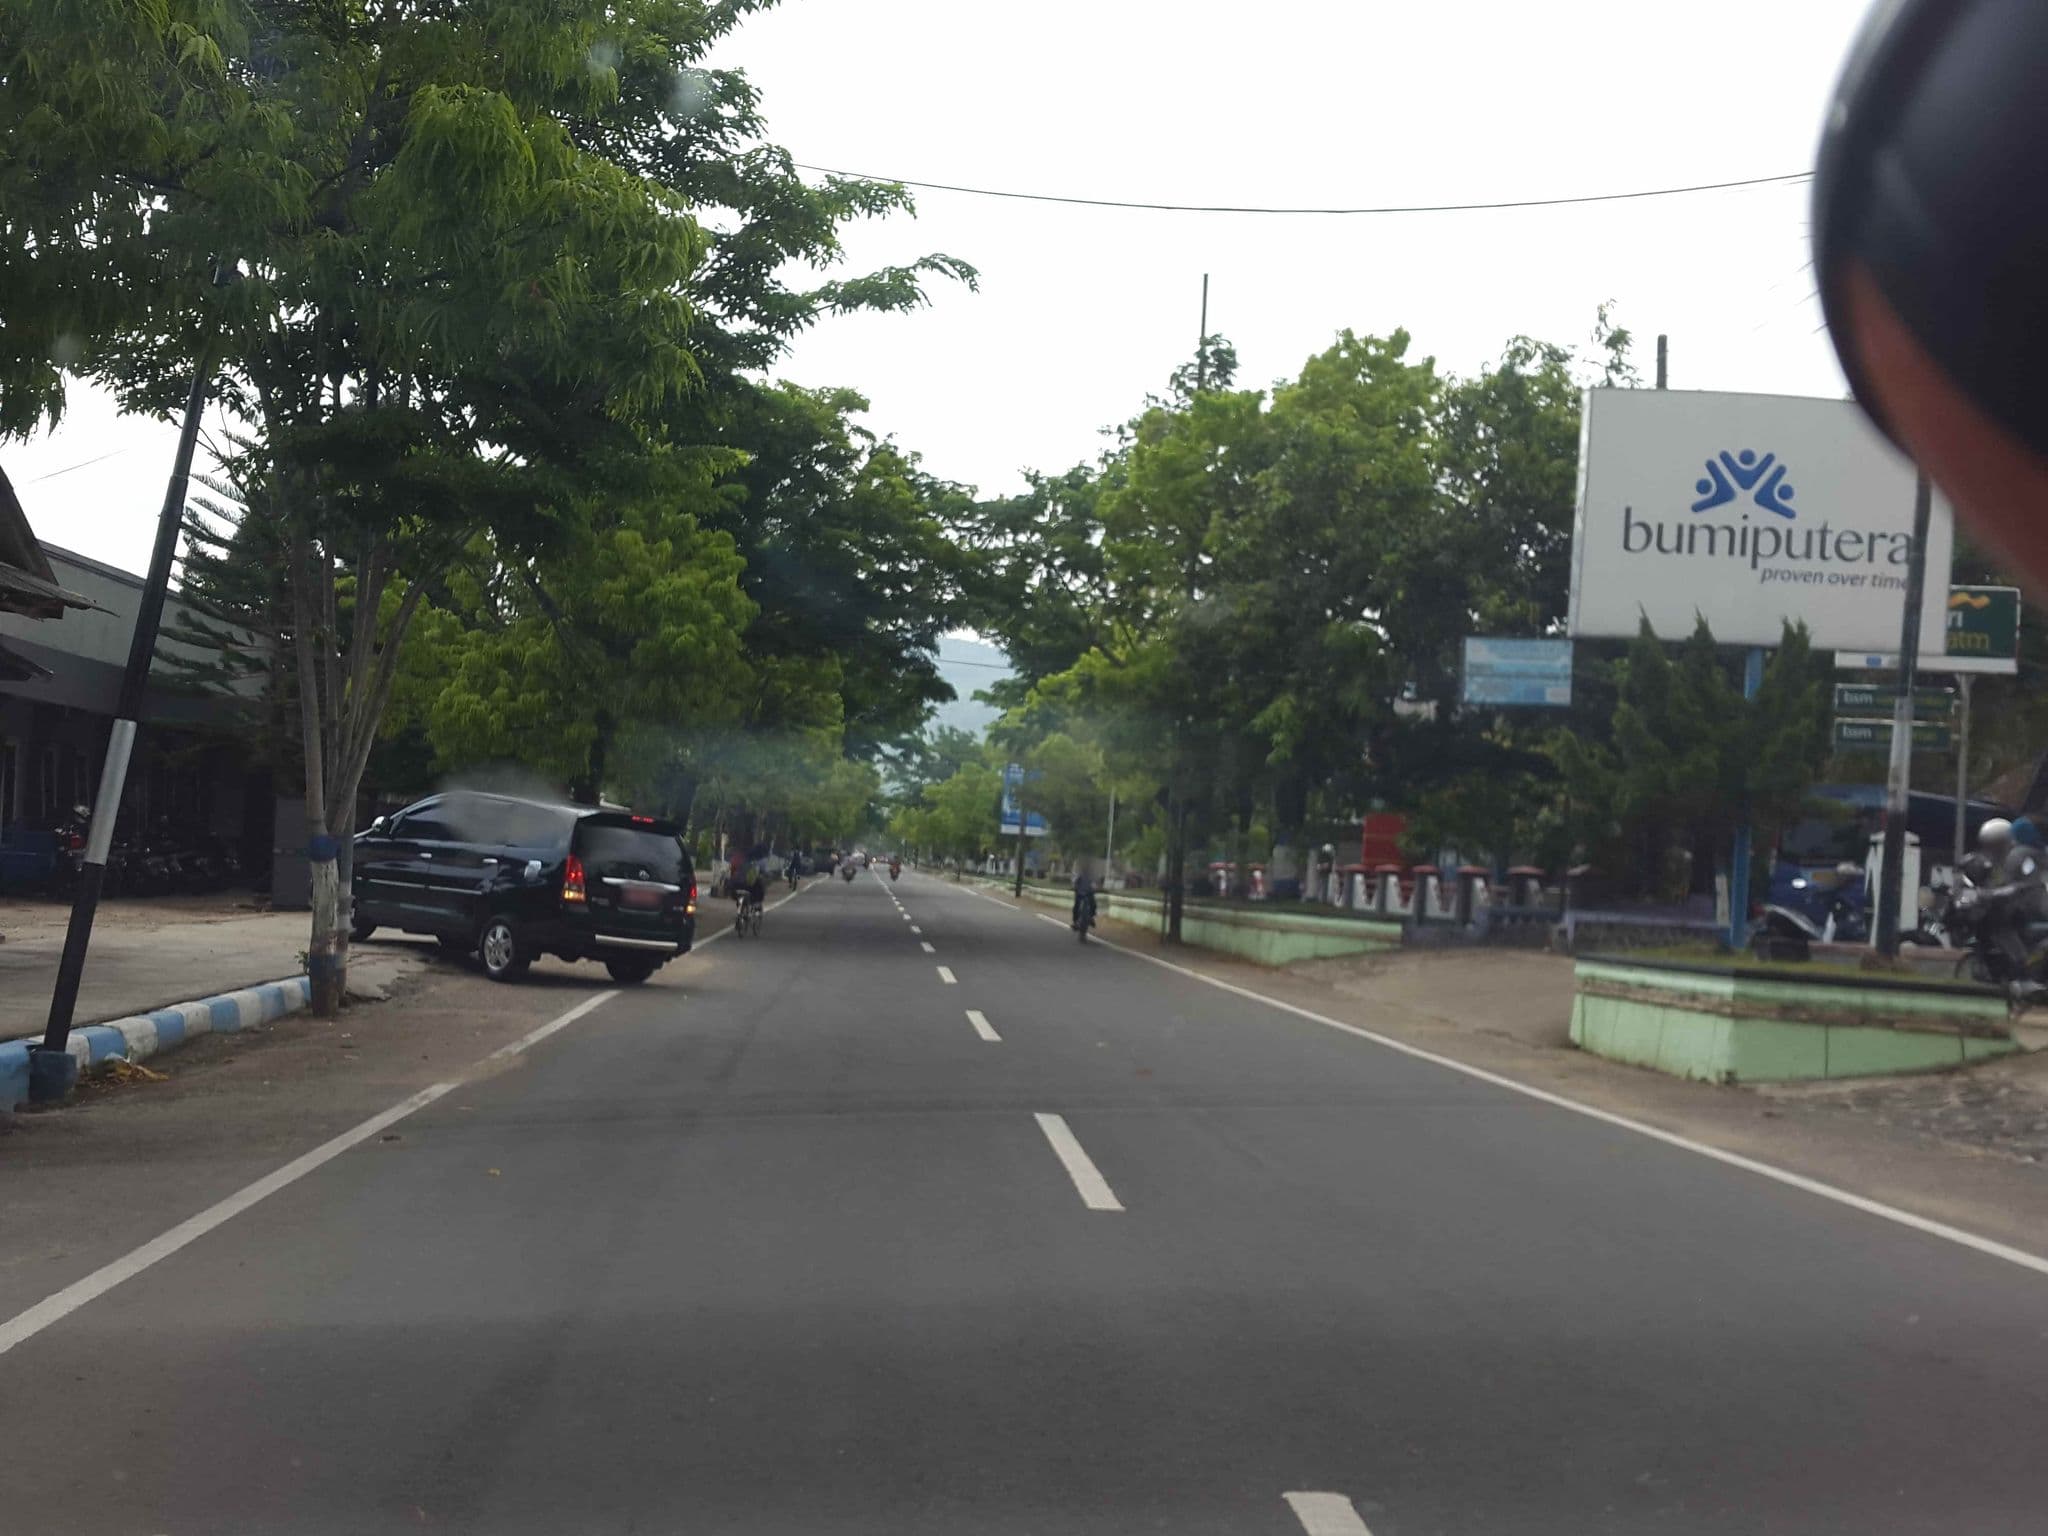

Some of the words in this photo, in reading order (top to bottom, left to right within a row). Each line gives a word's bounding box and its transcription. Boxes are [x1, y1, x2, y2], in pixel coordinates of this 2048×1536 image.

[1622, 505, 1911, 570] bumiputera
[1760, 566, 1824, 585] proven
[1827, 572, 1868, 587] over
